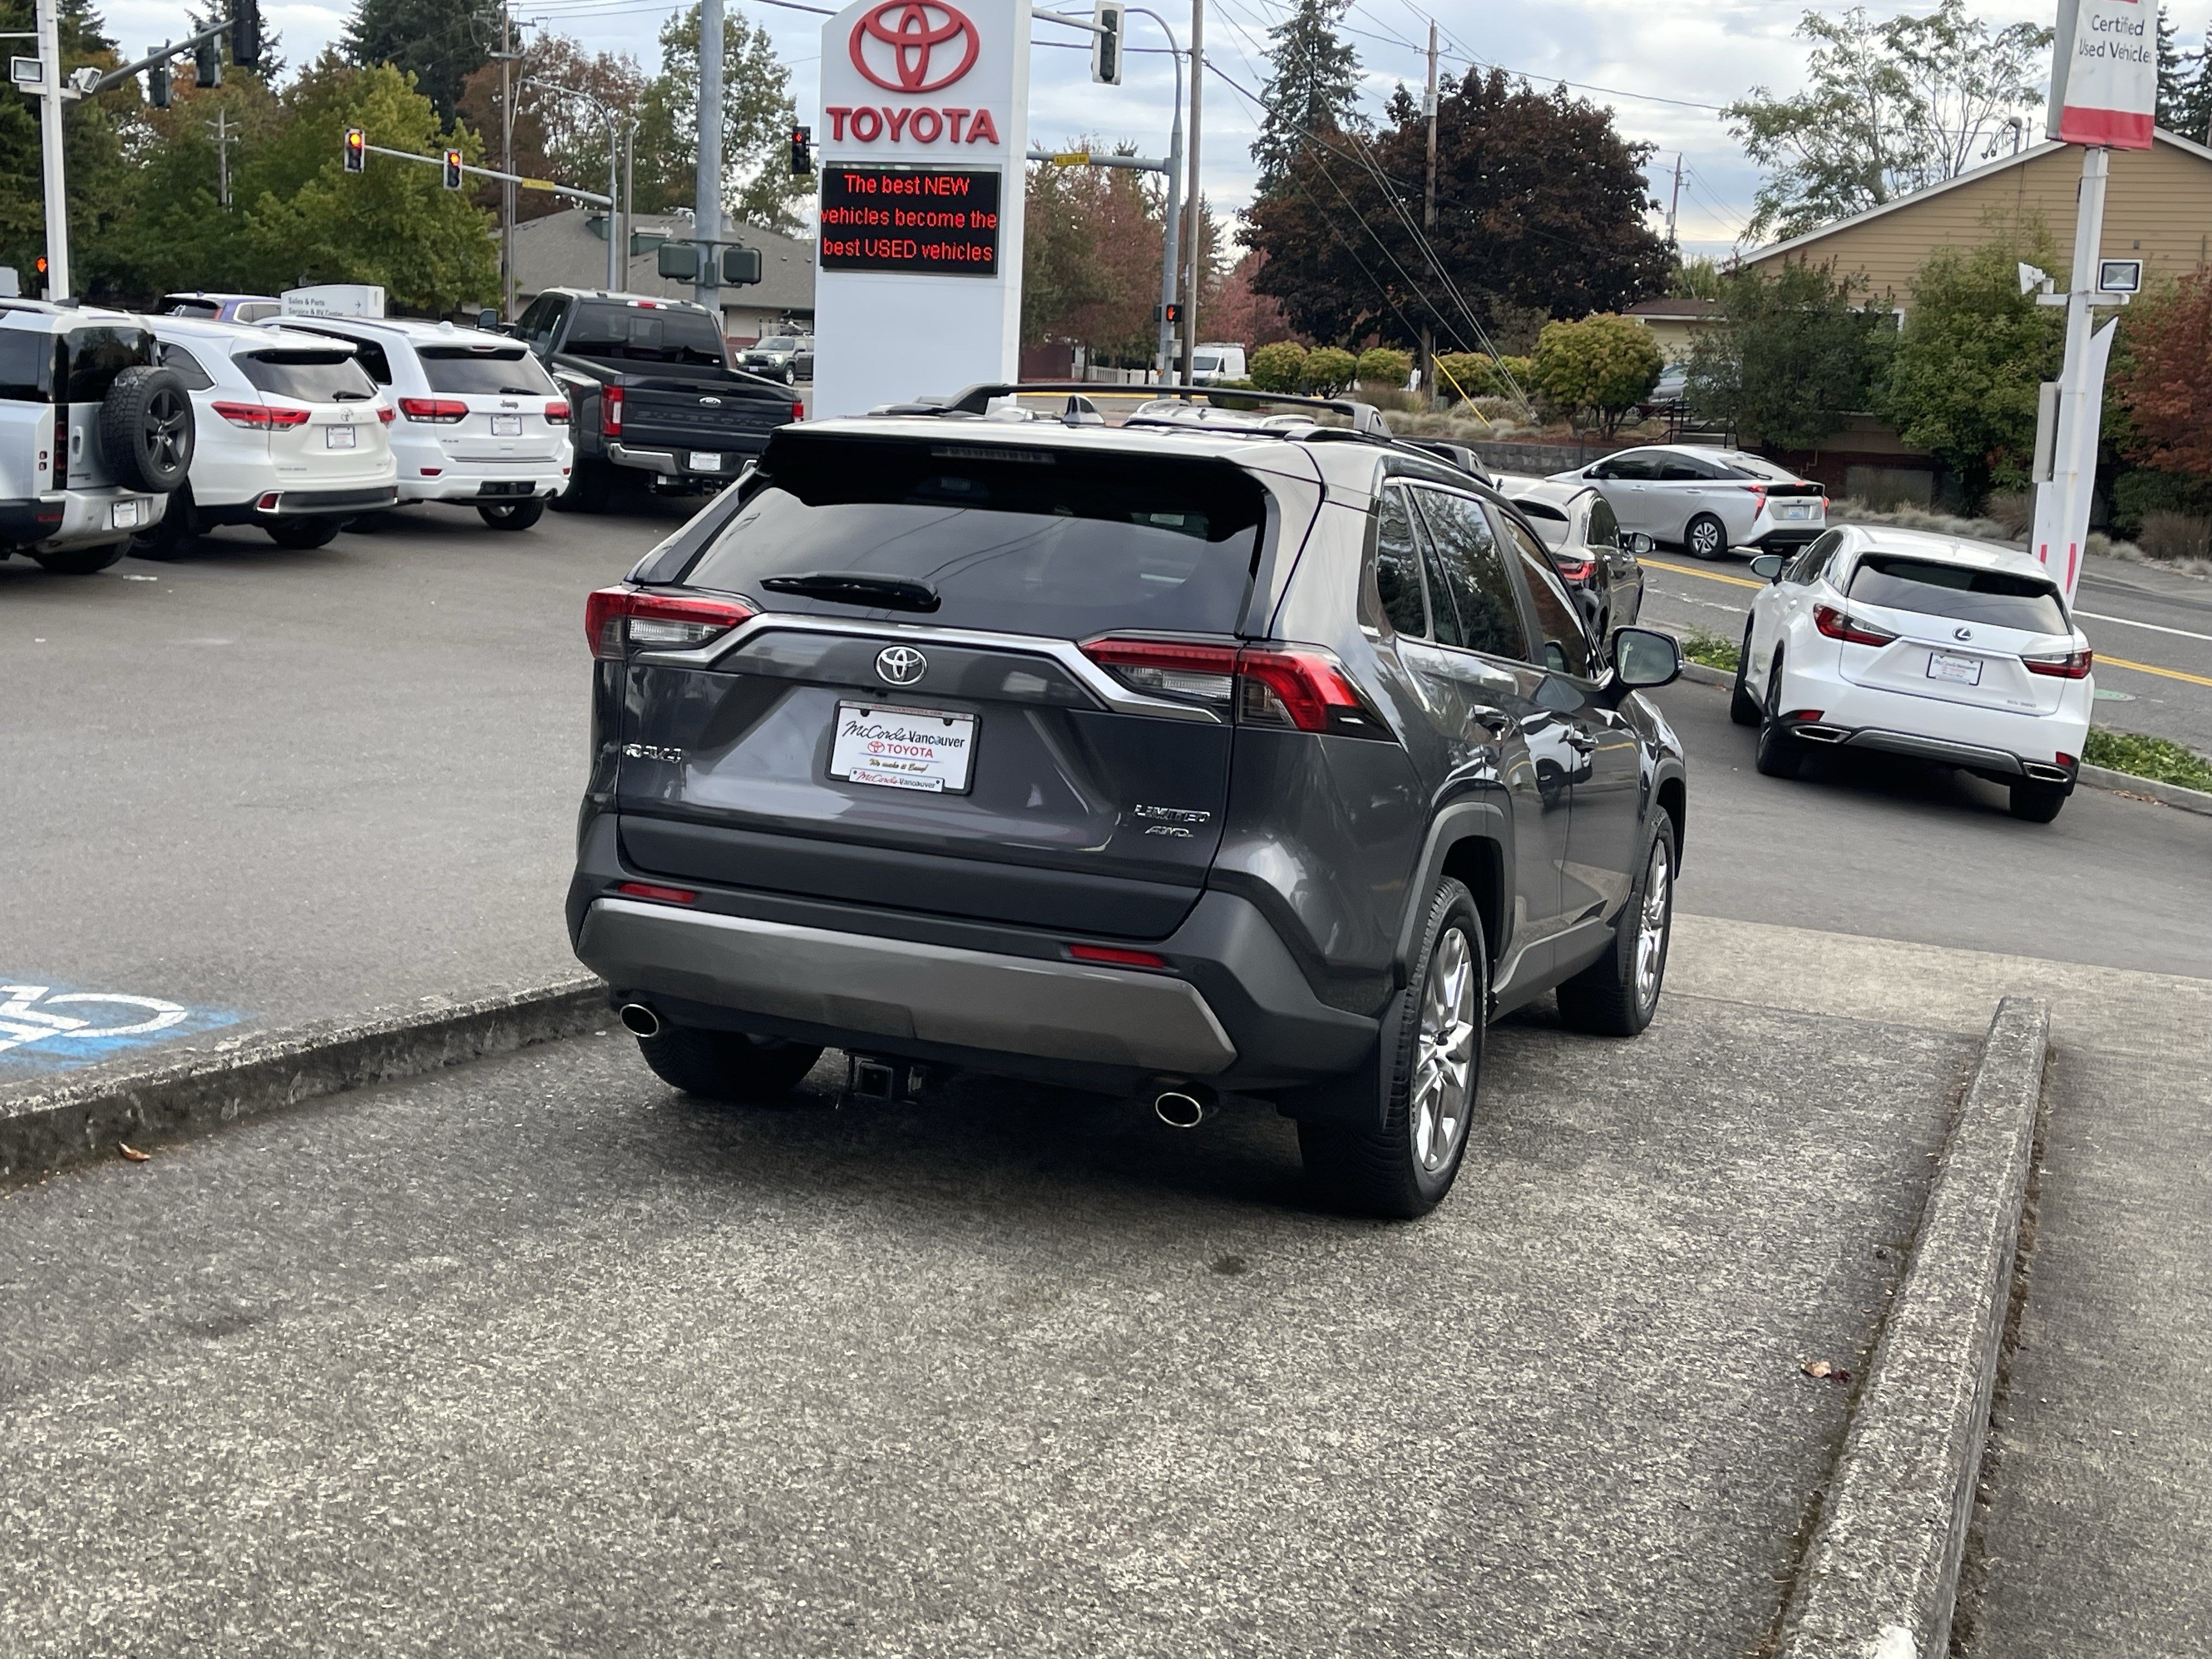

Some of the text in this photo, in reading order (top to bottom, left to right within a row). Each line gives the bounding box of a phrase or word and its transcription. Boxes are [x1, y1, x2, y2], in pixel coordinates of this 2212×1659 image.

[2079, 38, 2106, 58] Used
[826, 106, 1000, 144] TOYOTA
[844, 173, 970, 197] The best NEW
[820, 206, 997, 230] vehicles become the
[823, 237, 994, 262] best USED vehicles
[887, 743, 934, 758] TOYOTA
[1133, 804, 1211, 822] LIMITED
